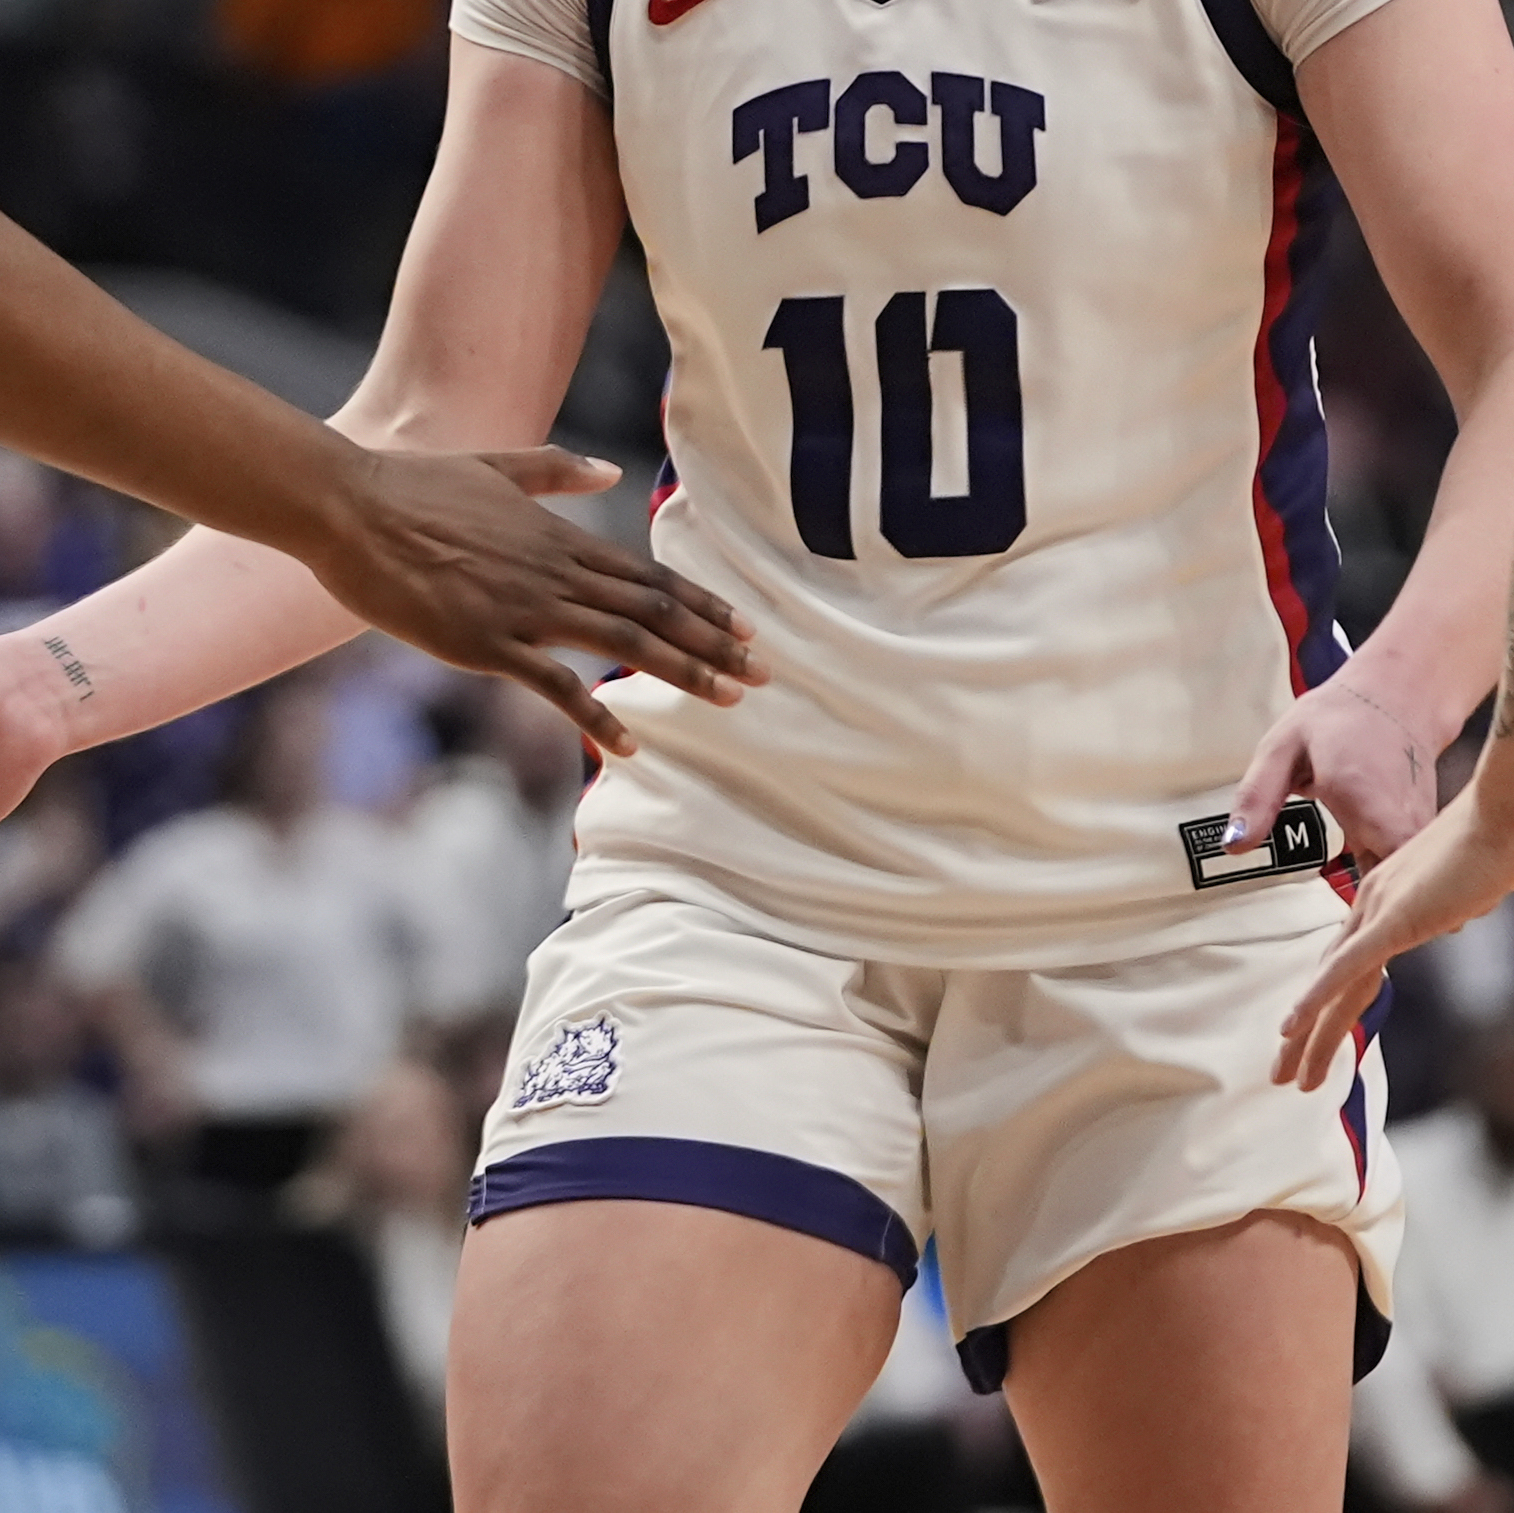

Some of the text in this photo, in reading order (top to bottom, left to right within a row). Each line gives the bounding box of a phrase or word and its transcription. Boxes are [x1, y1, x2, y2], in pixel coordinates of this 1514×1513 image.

[732, 70, 1047, 234] TCU
[762, 288, 1028, 561] 10
[1284, 821, 1310, 851] M
